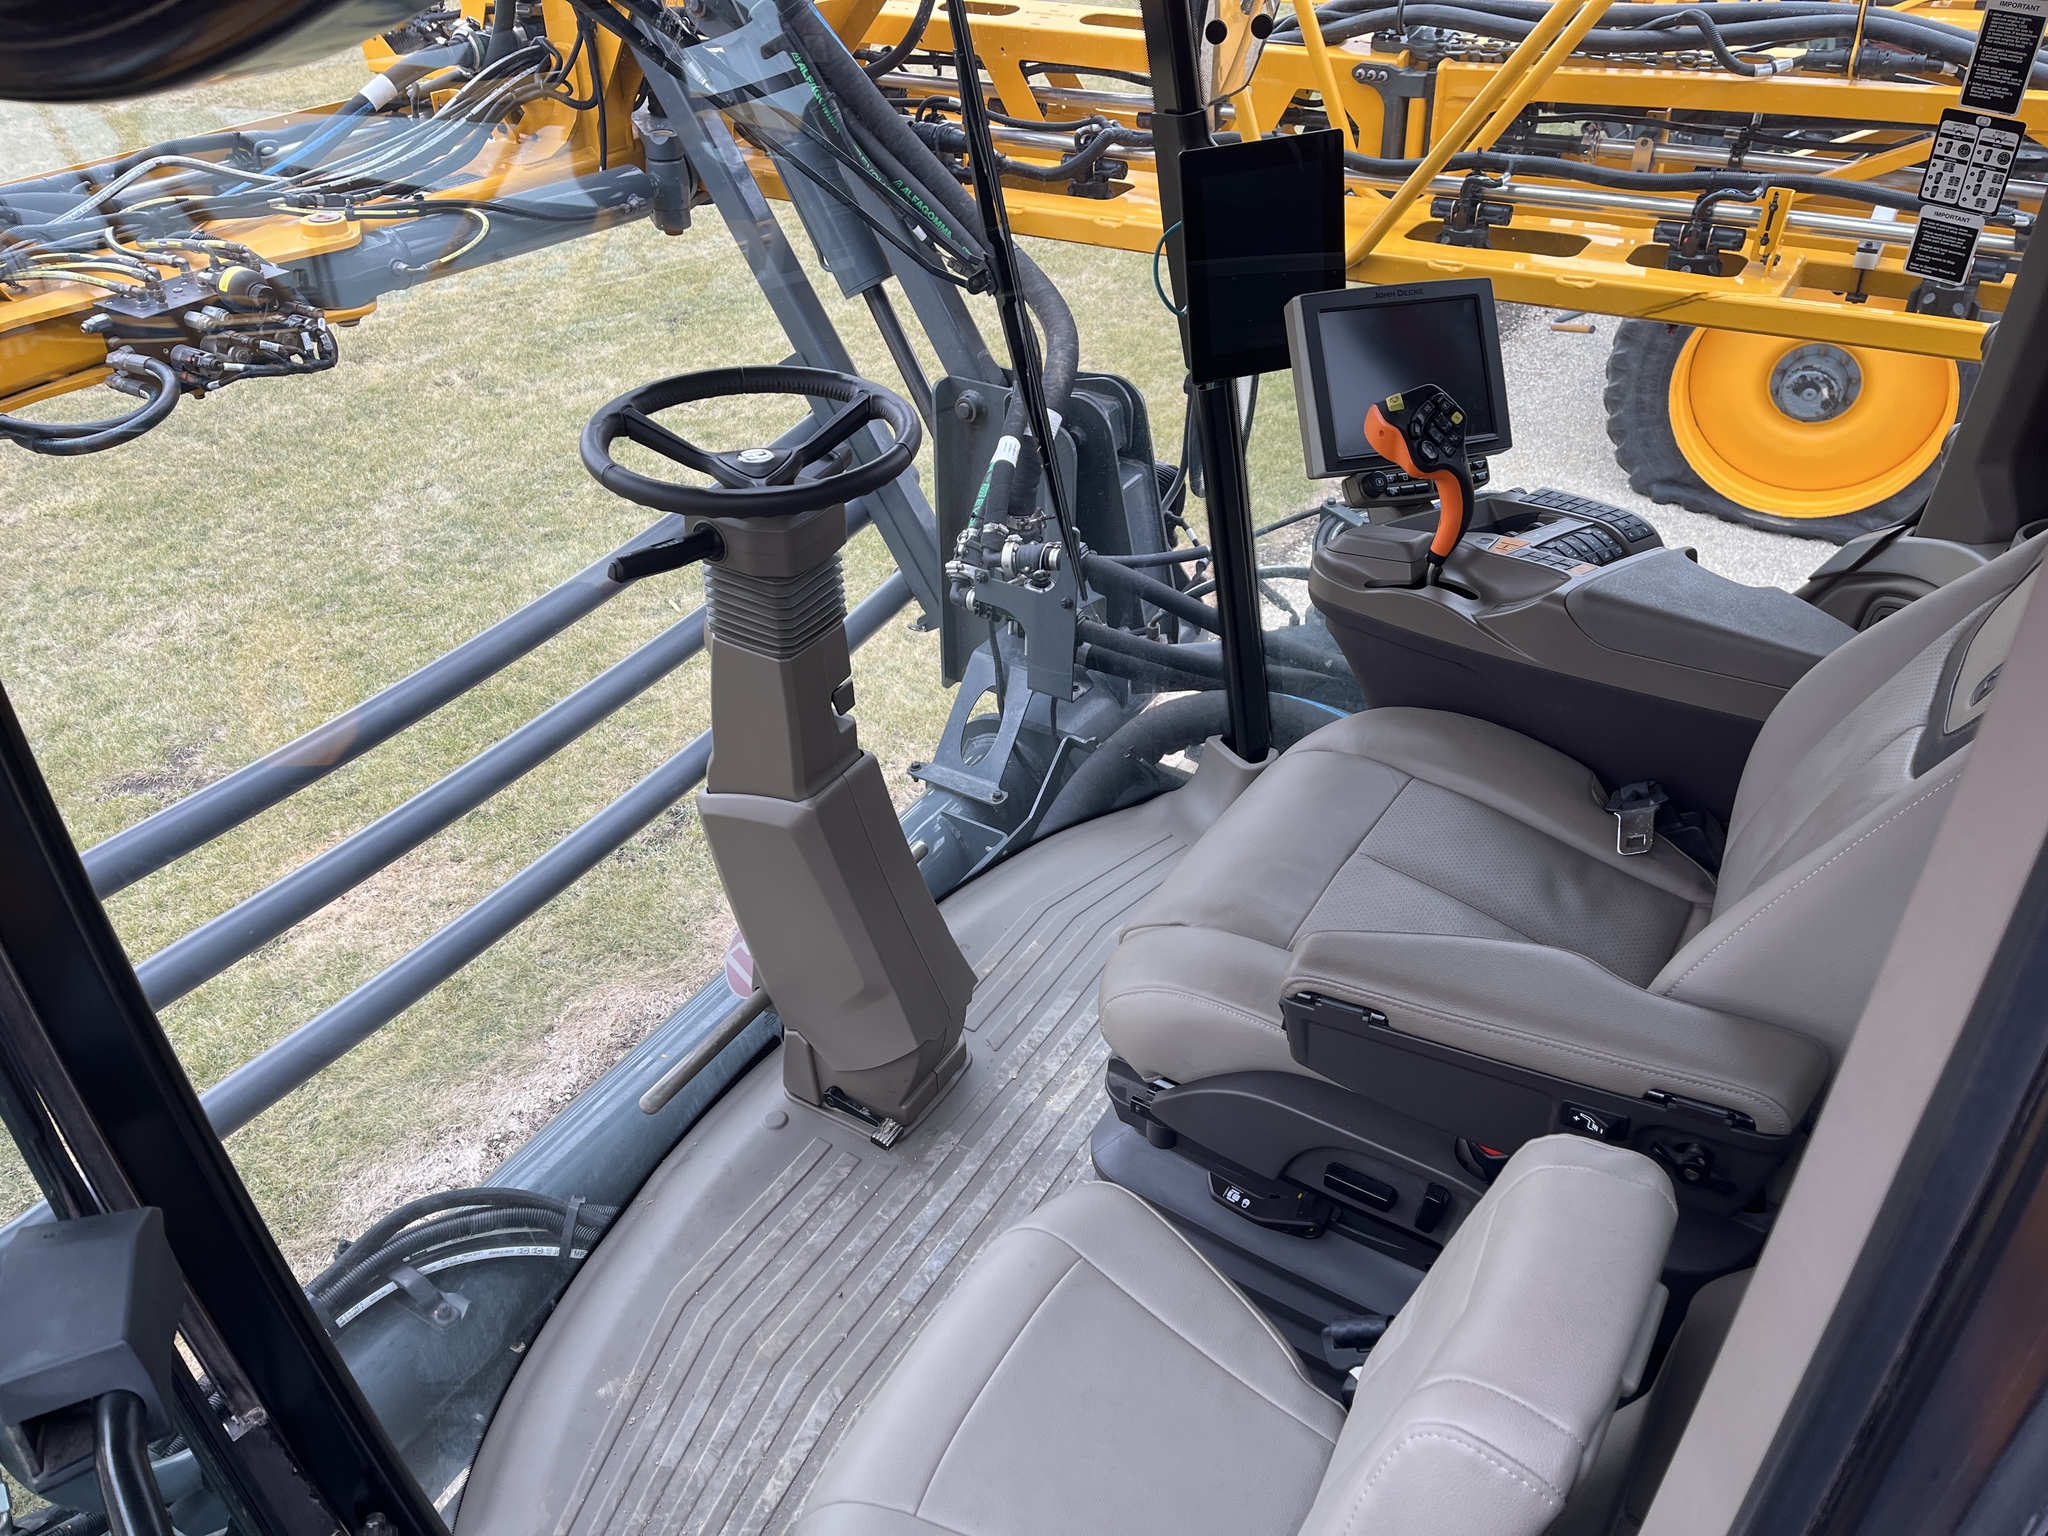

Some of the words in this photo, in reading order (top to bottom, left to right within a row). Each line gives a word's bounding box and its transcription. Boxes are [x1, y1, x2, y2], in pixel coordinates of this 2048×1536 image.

[1999, 1, 2041, 11] IMPORTANT
[901, 187, 953, 239] ALFAGOMMA
[1934, 211, 1971, 223] IMPORTANT
[1397, 289, 1424, 297] DEERE
